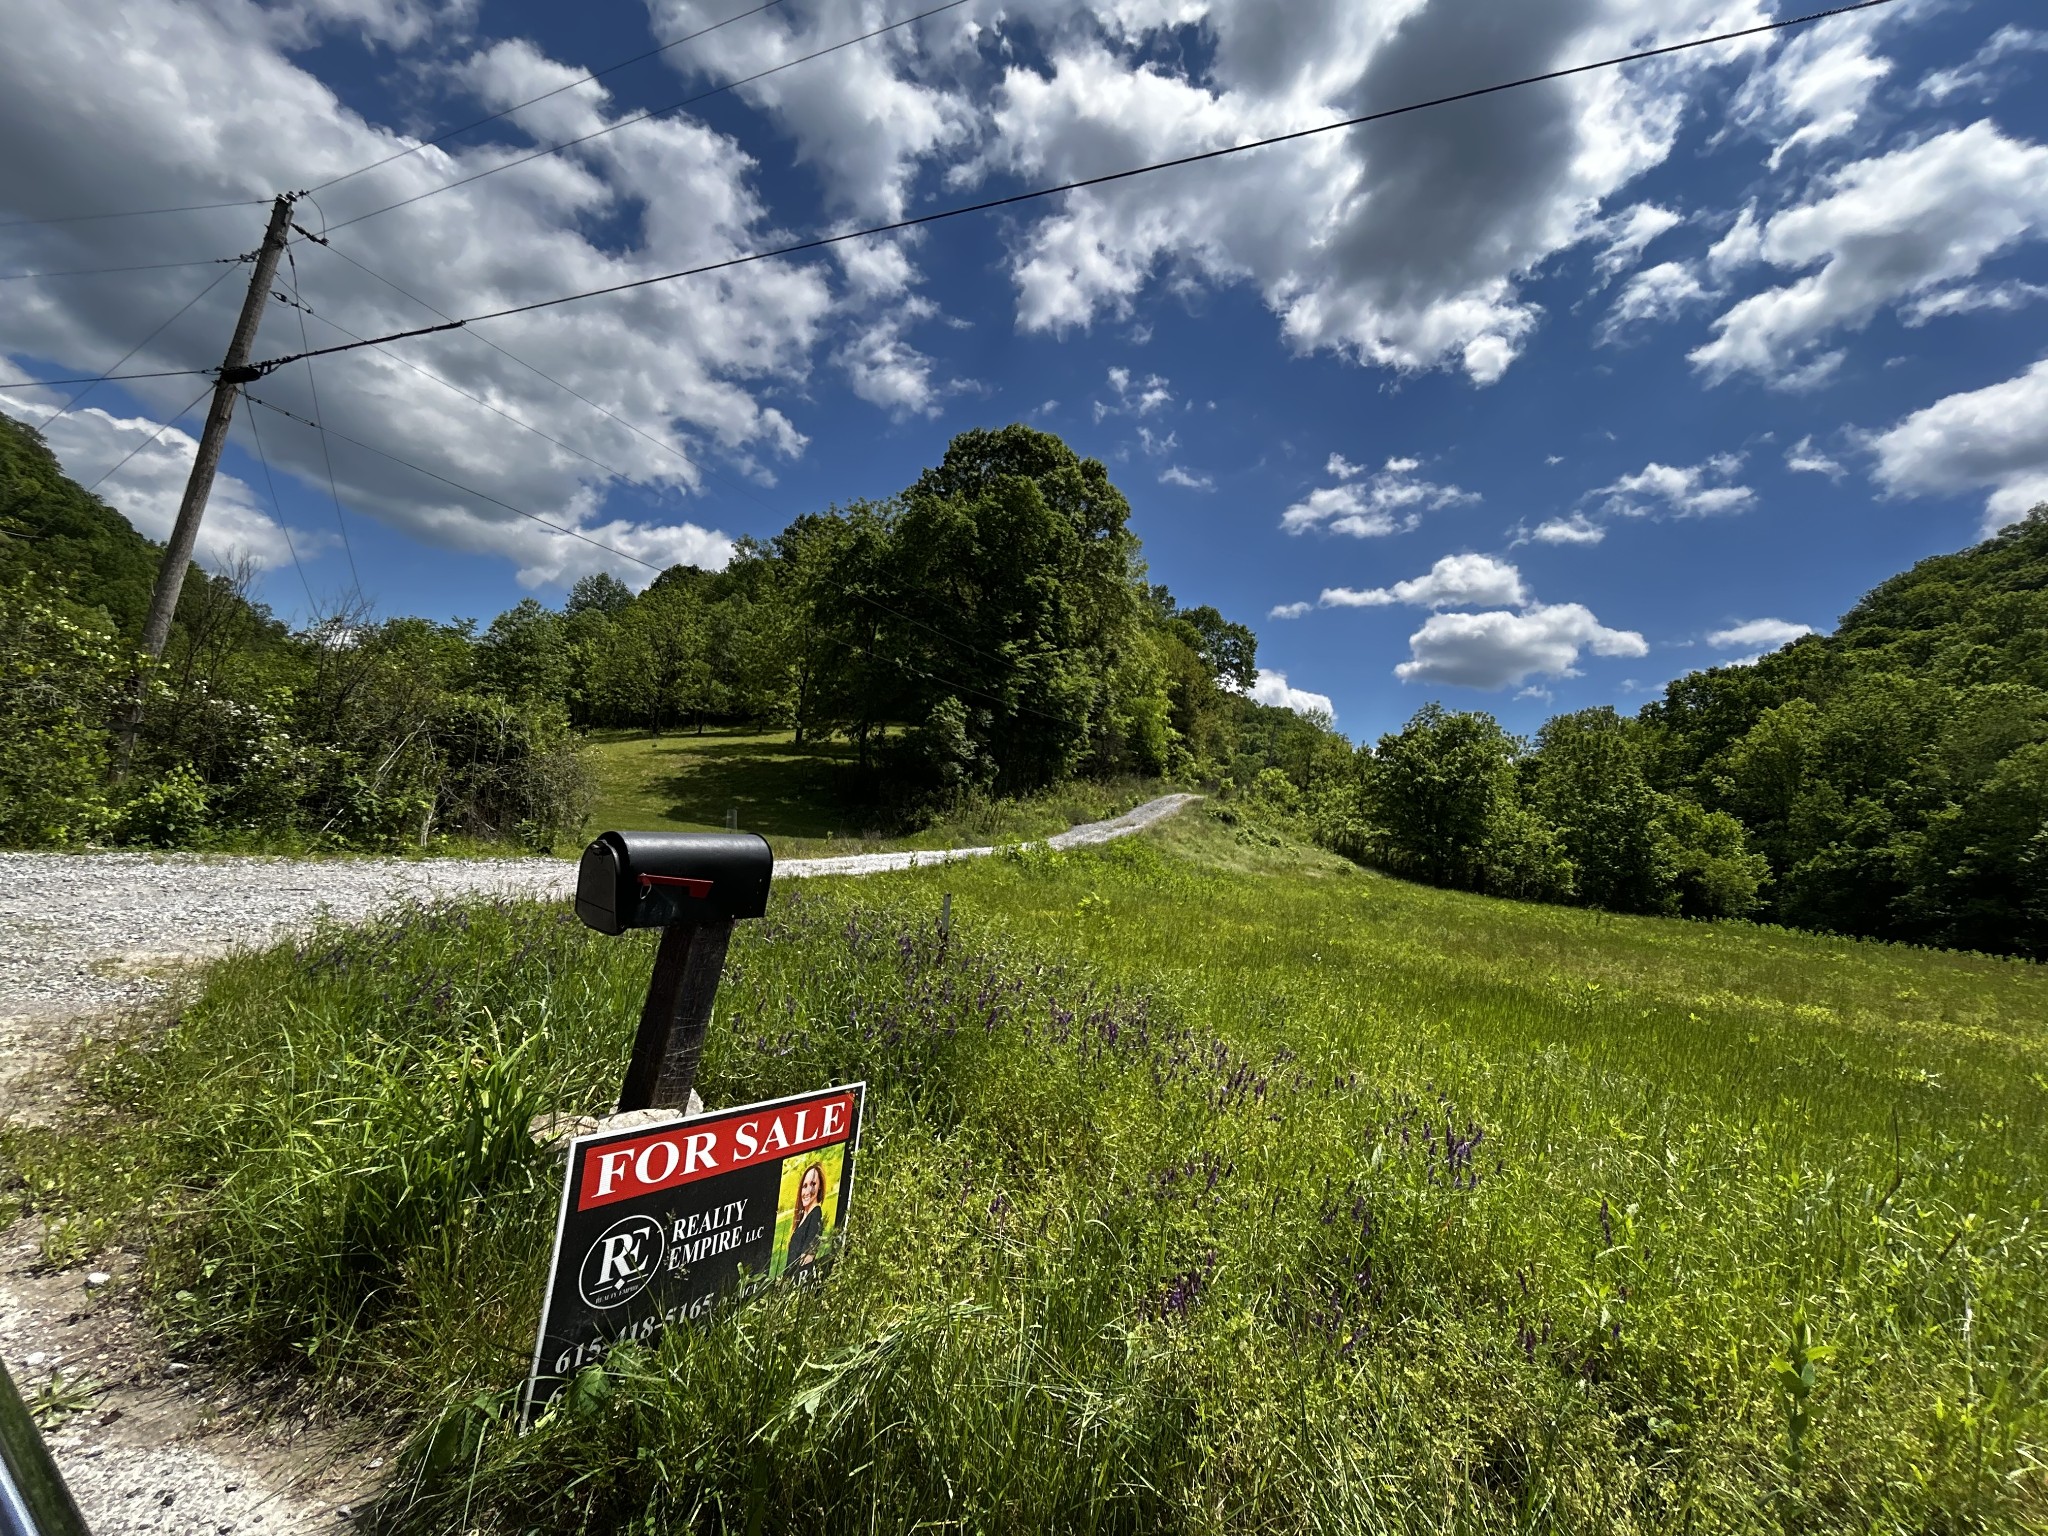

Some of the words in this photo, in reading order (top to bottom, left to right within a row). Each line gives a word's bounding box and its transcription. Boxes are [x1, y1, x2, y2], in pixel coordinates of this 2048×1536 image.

[591, 1132, 720, 1199] FOR
[732, 1101, 846, 1162] SALE
[671, 1198, 749, 1244] REALTY
[594, 1226, 651, 1287] RE
[666, 1225, 744, 1272] EMPIRE
[745, 1225, 765, 1244] LLC
